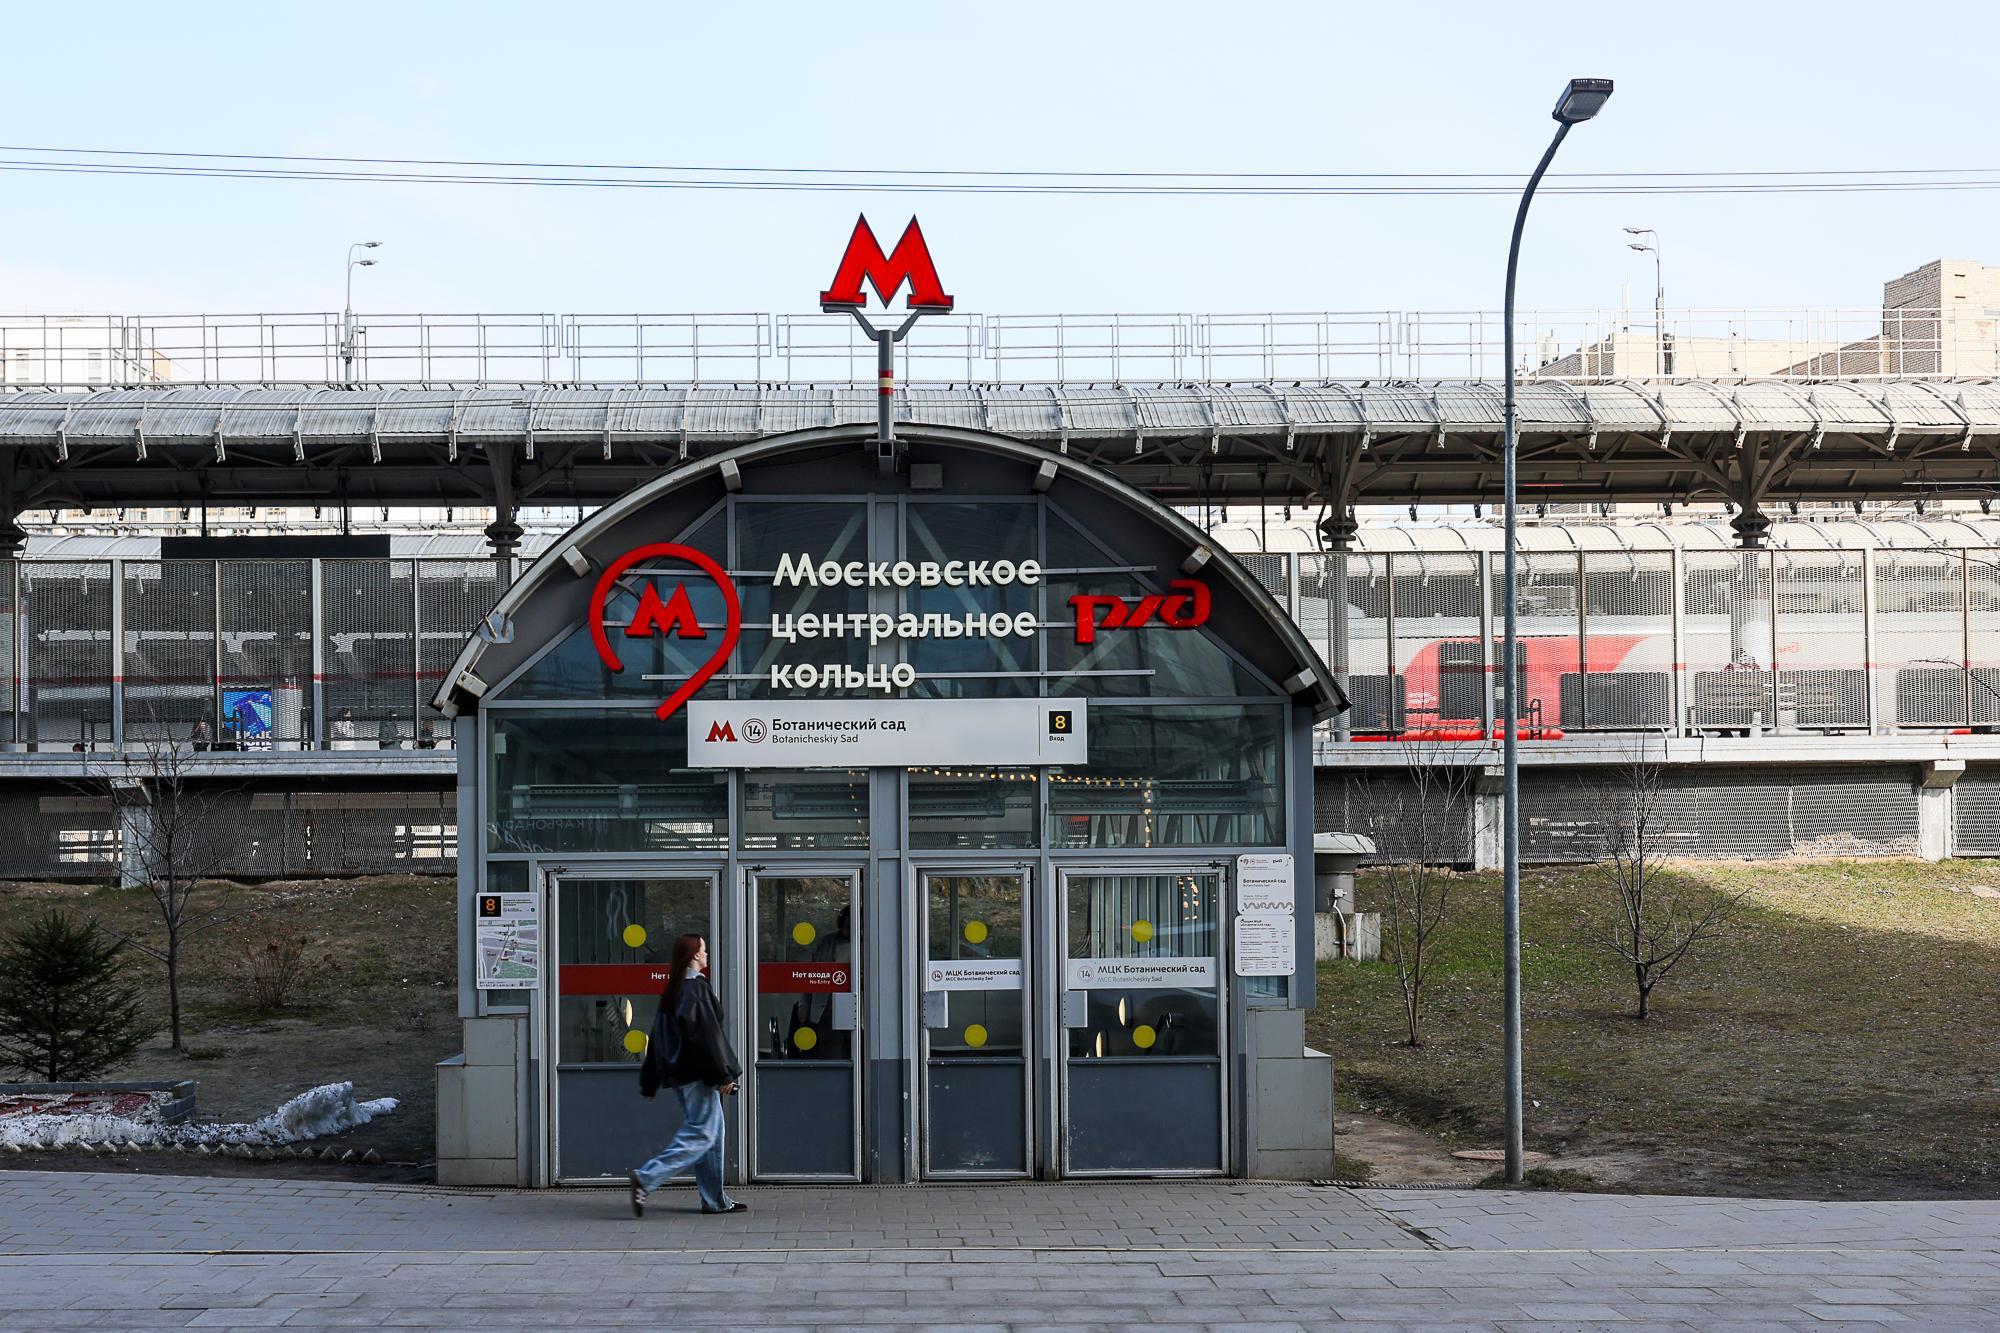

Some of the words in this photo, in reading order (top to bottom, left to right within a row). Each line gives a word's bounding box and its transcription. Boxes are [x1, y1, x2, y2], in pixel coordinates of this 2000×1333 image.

[772, 552, 1042, 588] Московское
[771, 611, 1038, 647] центральное
[770, 662, 916, 694] кольцо
[771, 717, 878, 732] Ботанический
[880, 719, 907, 732] сад
[1055, 715, 1066, 730] 8
[771, 733, 838, 745] Botanicheskiy
[840, 733, 860, 744] Sad
[485, 898, 496, 911] 8
[792, 971, 807, 979] Нет
[945, 969, 963, 977] МЦК
[1097, 965, 1122, 974] МЦК
[1123, 964, 1188, 974] Ботанический
[651, 972, 666, 980] Нет
